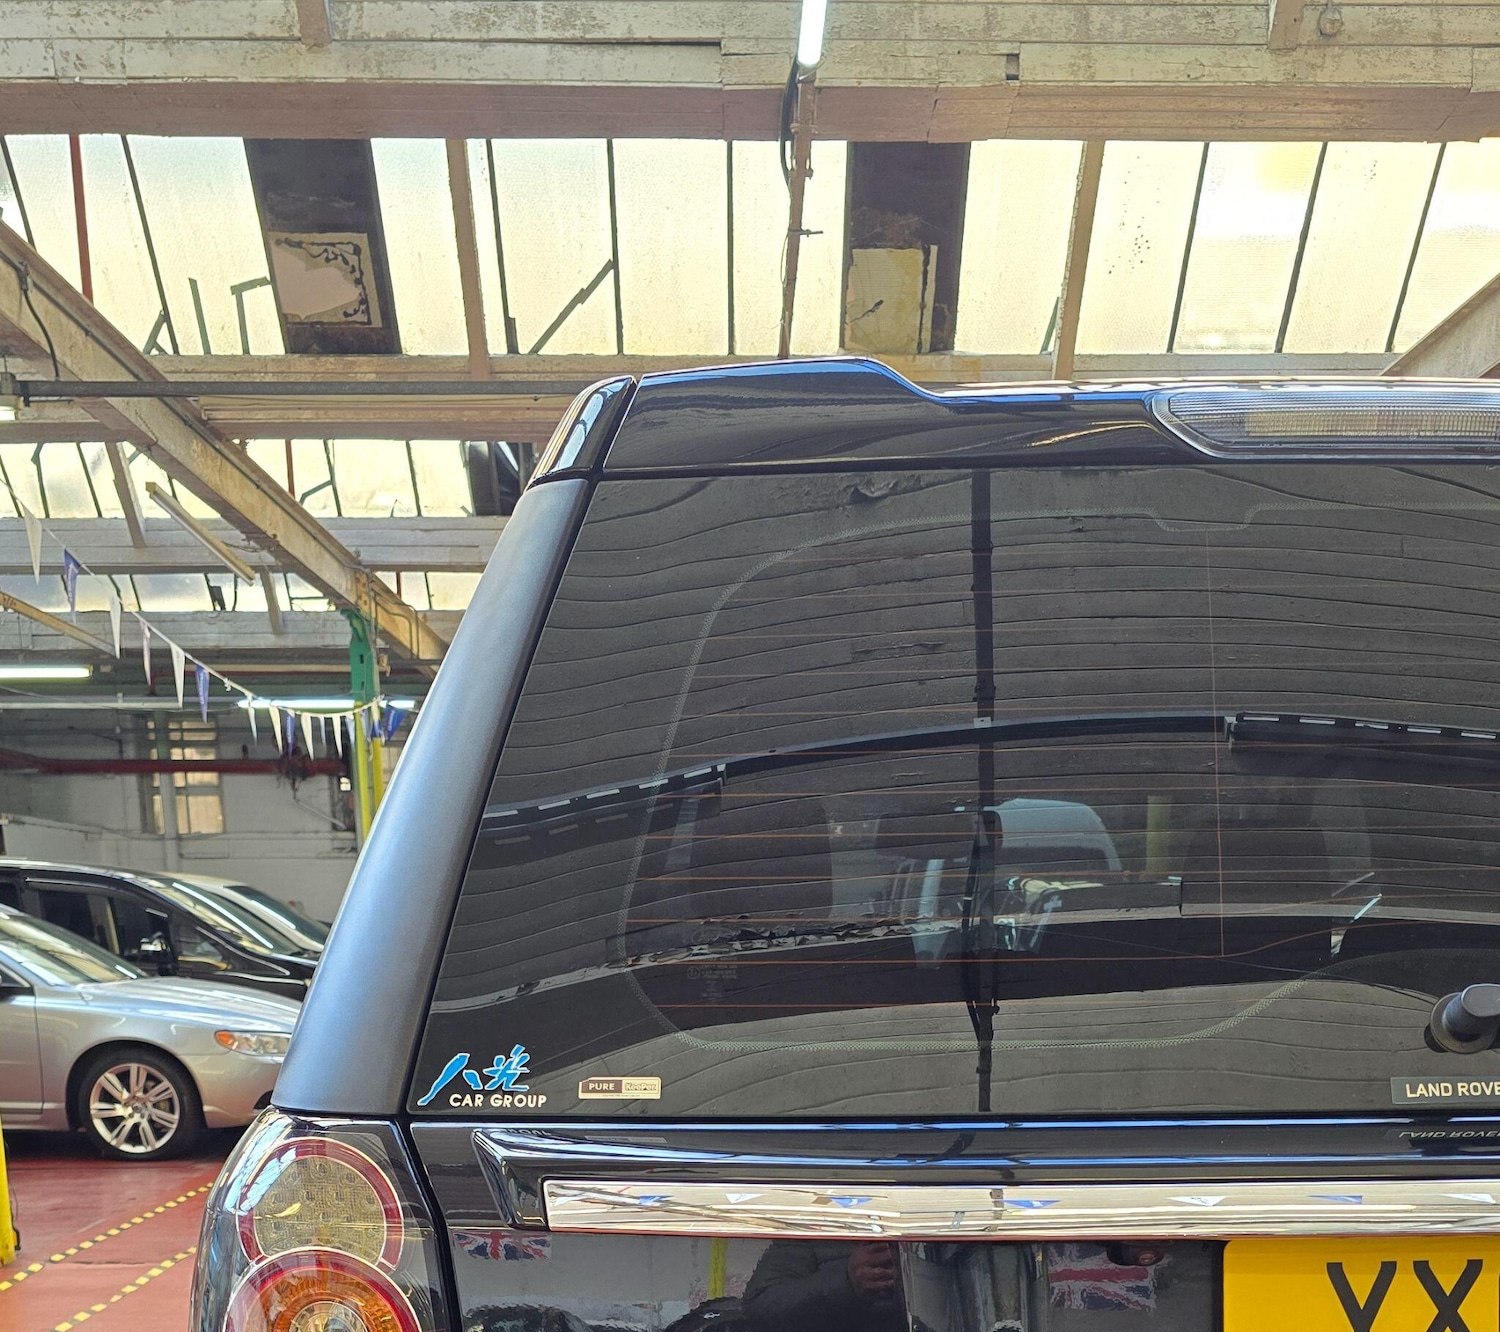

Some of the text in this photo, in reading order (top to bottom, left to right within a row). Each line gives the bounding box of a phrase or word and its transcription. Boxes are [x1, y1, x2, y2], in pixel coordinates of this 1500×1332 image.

[588, 1082, 615, 1091] PURE
[1405, 1082, 1453, 1098] LAND
[449, 1093, 547, 1108] CAR GROUP
